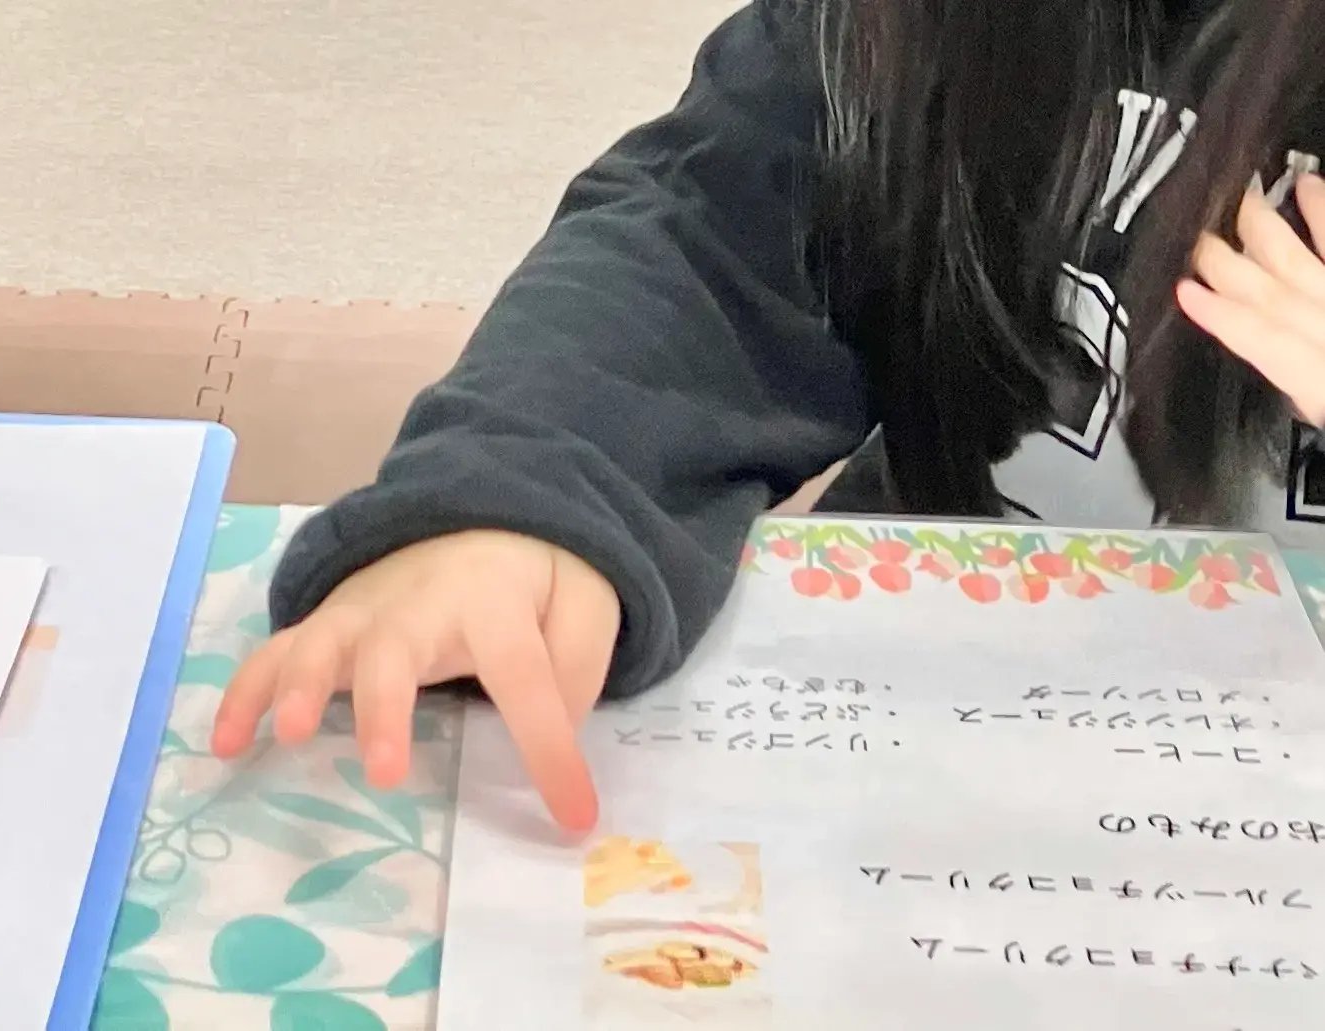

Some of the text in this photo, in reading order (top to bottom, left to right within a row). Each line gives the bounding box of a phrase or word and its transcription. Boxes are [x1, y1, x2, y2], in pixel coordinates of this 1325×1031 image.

[1022, 685, 1240, 704] メロンソーダ
[953, 707, 1254, 732] オレンジジュース
[616, 730, 867, 752] リンゴジュース
[1114, 742, 1261, 764] コーヒー
[859, 866, 1312, 909] フルーツチョコクリーム
